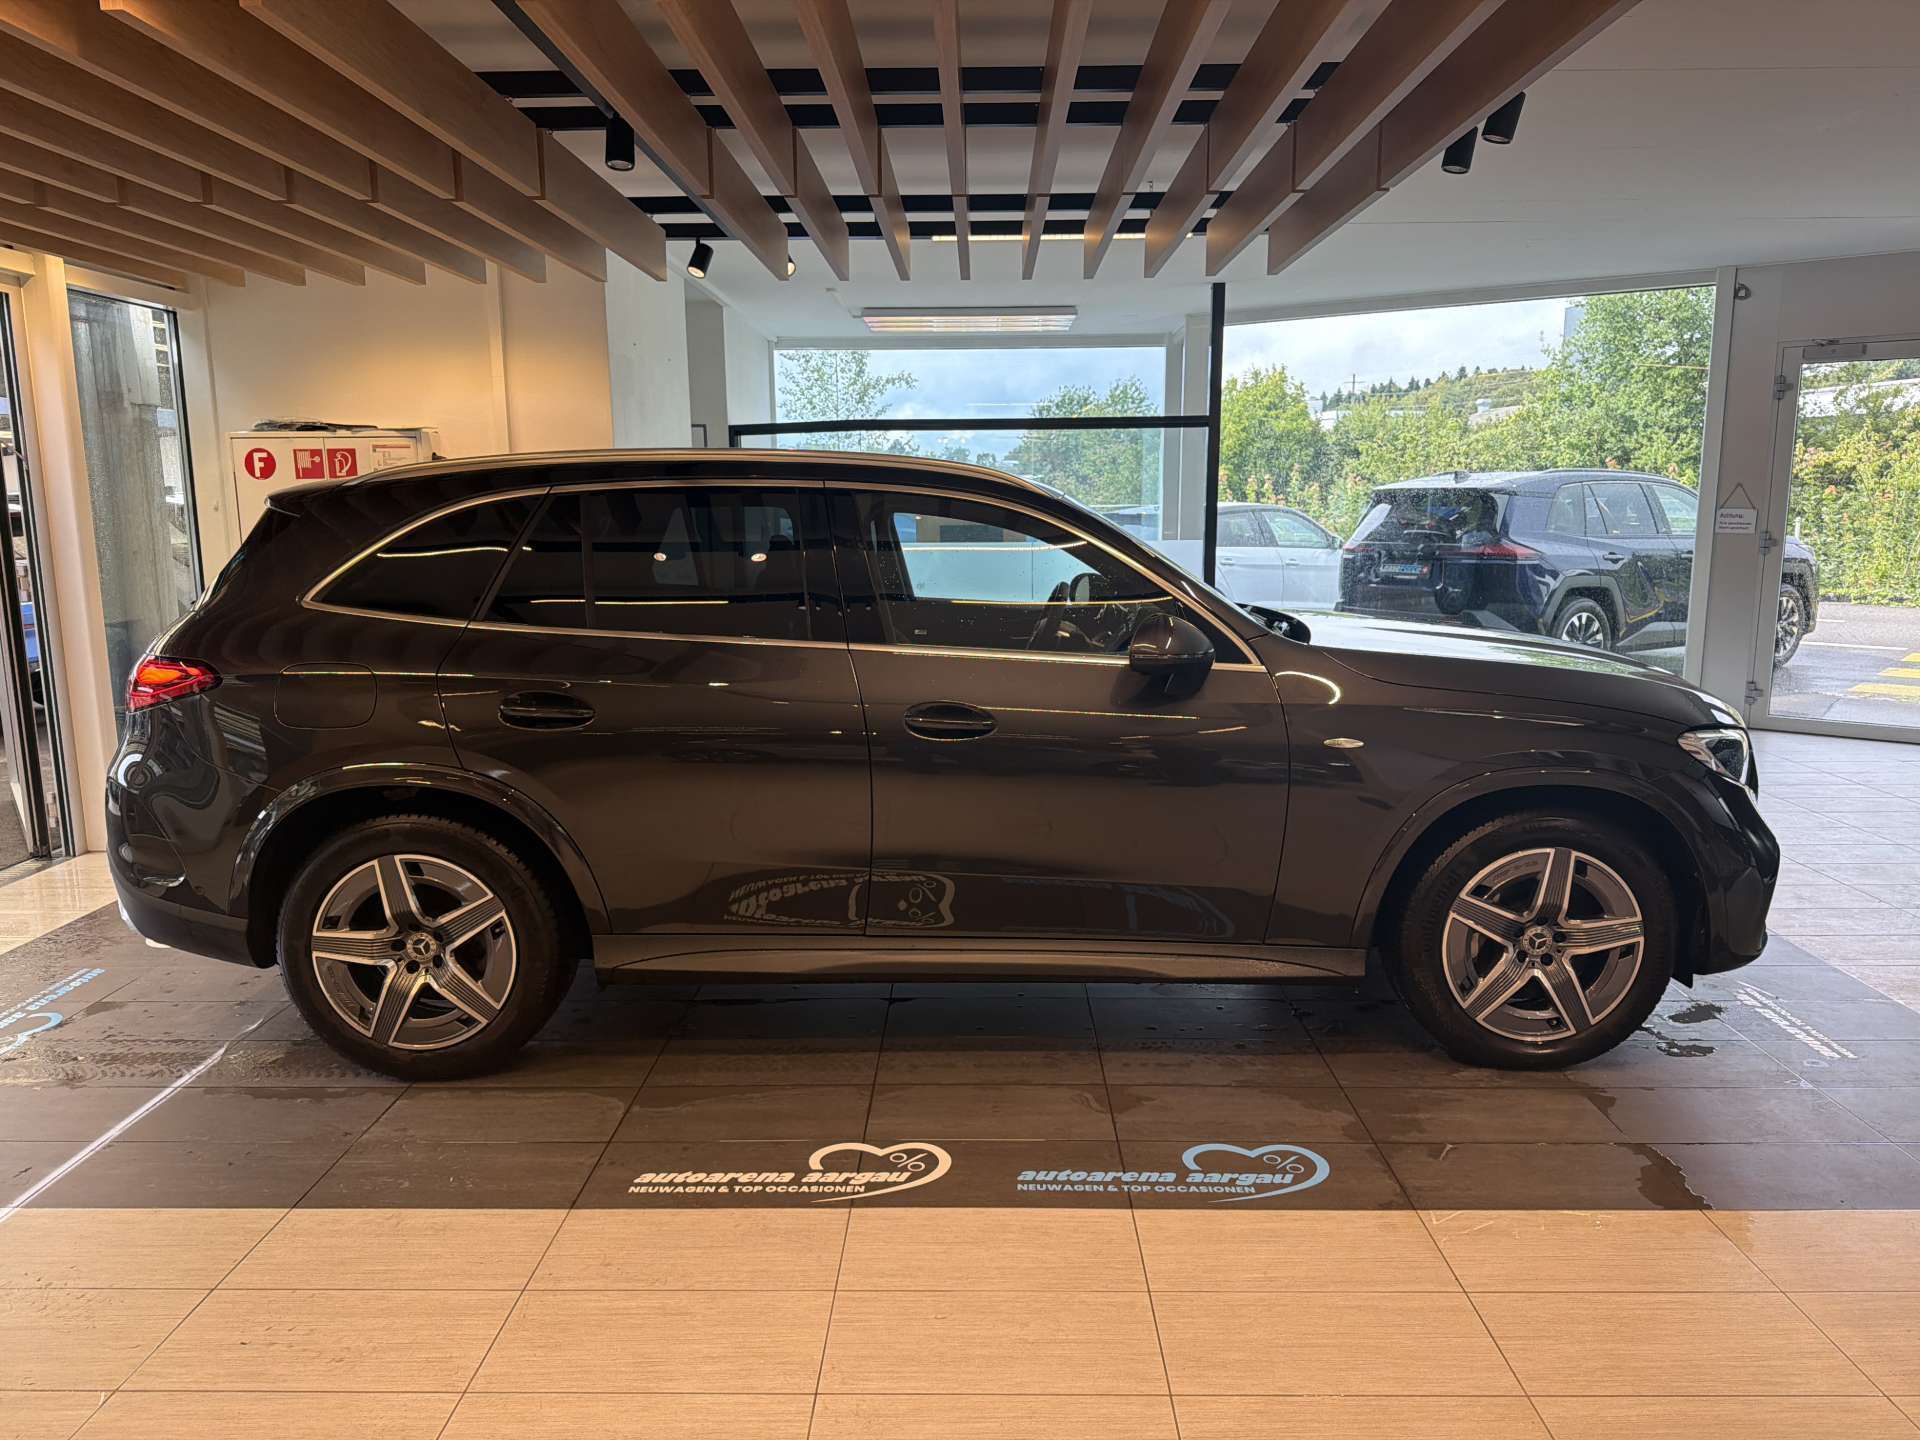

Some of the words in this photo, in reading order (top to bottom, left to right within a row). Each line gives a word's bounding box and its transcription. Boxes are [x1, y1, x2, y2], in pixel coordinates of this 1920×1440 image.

[253, 452, 268, 478] F
[633, 1170, 796, 1184] autoarena
[801, 1170, 913, 1185] aargau
[1017, 1168, 1178, 1183] autoarena
[1185, 1171, 1294, 1185] aargau
[628, 1185, 717, 1194] NEUWAGEN
[718, 1185, 730, 1194] &
[733, 1185, 764, 1194] TOP
[765, 1185, 866, 1194] OCCASIONEN
[1017, 1183, 1104, 1192] NEUWAGEN
[1108, 1184, 1119, 1193] &
[1122, 1184, 1151, 1193] TOP
[1153, 1185, 1256, 1194] OCCASIONEN
